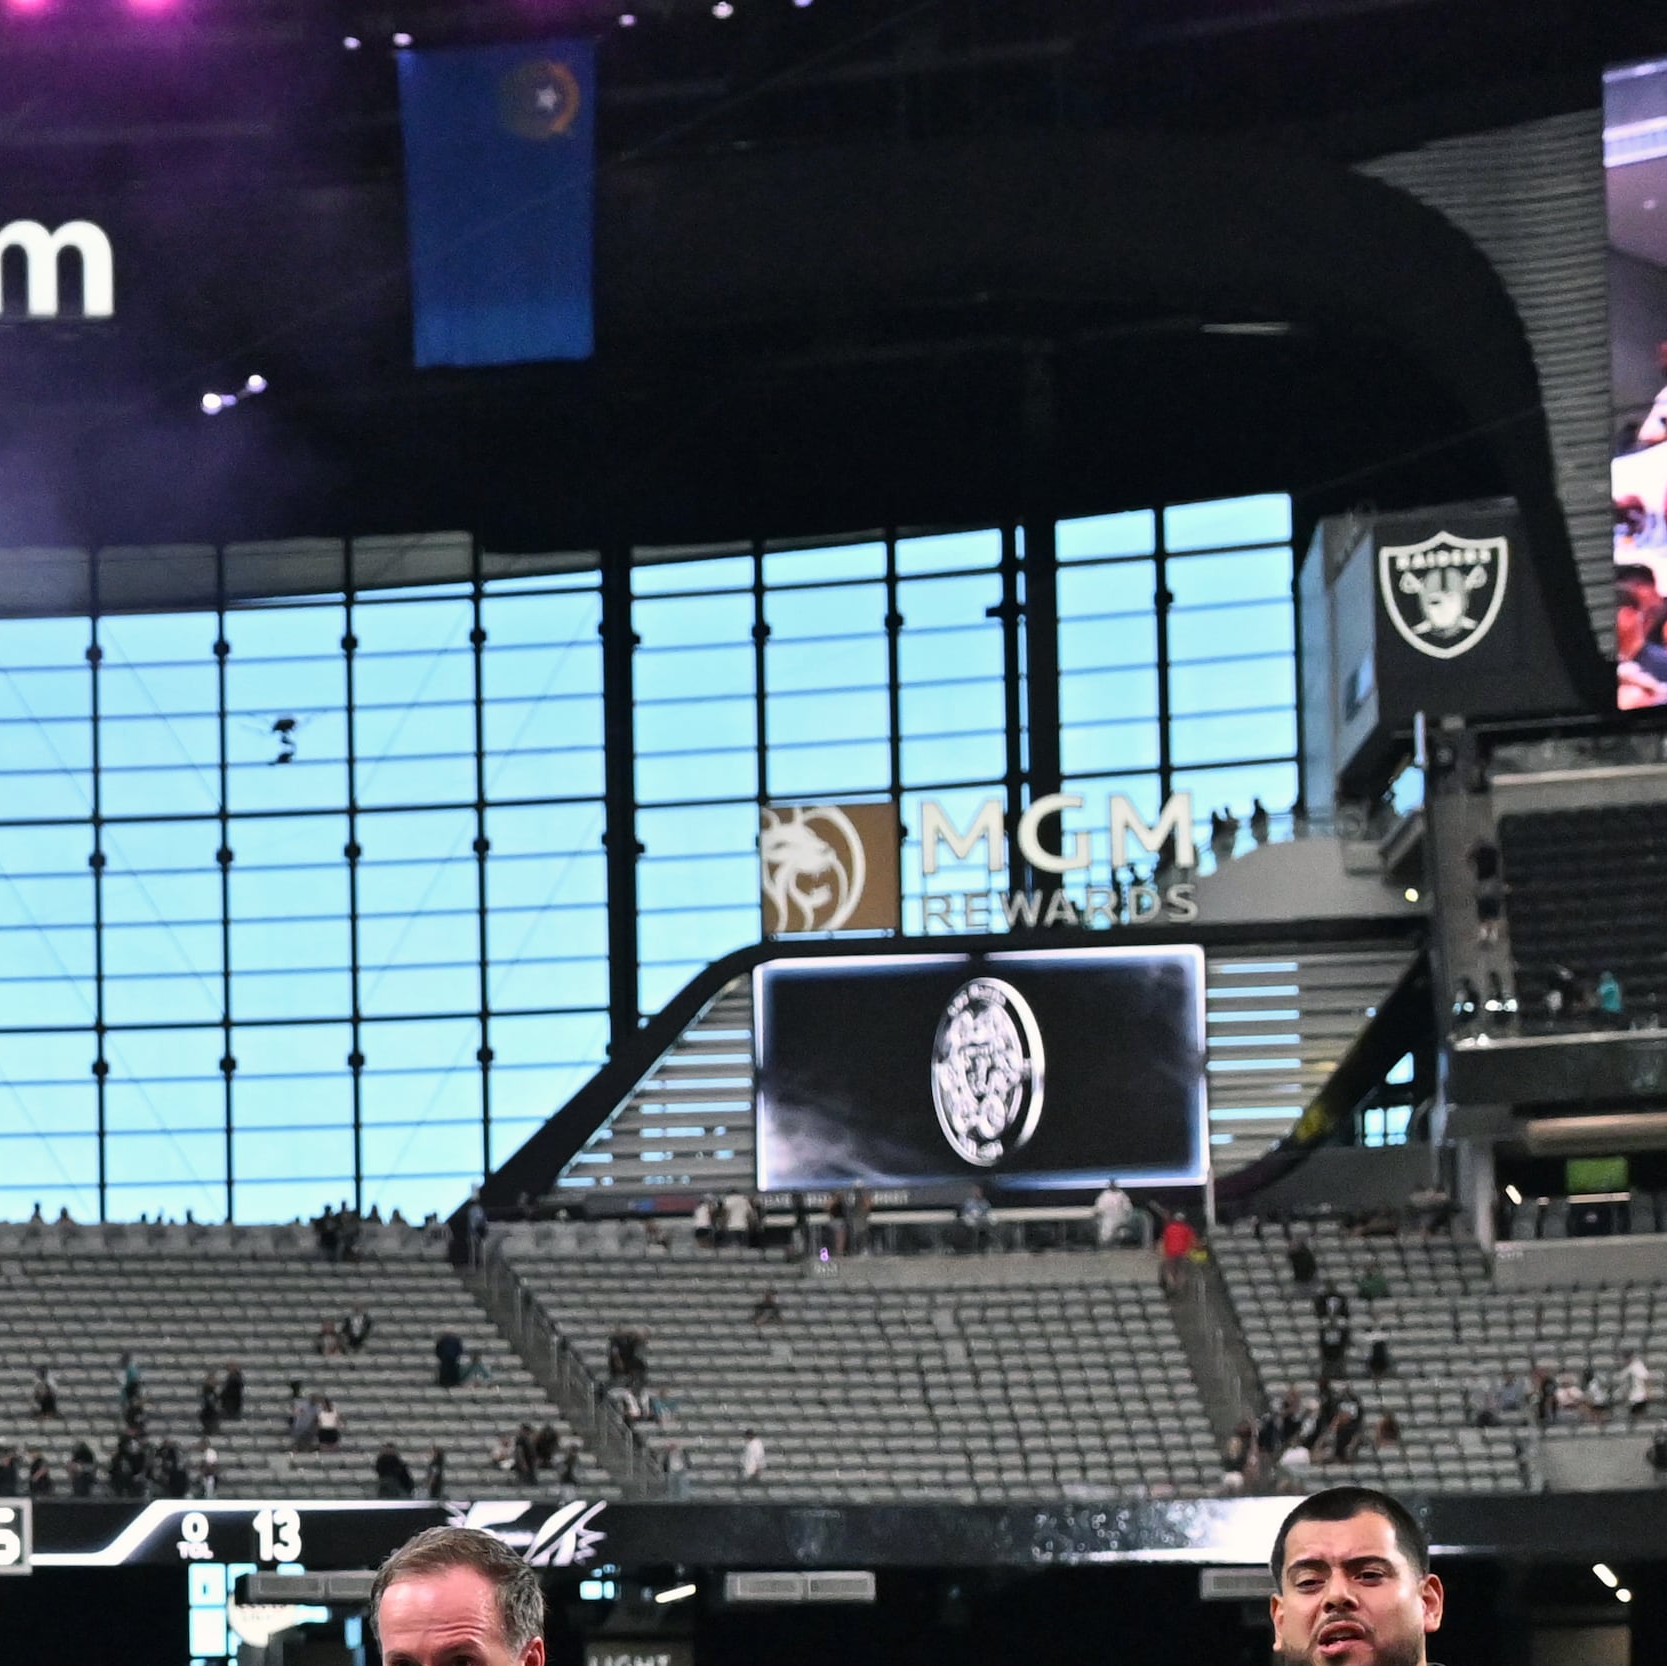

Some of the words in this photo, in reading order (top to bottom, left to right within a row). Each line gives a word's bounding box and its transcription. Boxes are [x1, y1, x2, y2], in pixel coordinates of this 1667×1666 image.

[1395, 548, 1491, 571] RAIDERS
[921, 790, 1199, 874] MGM
[923, 883, 1200, 934] REWARDS
[181, 1512, 210, 1542] 0
[253, 1509, 303, 1562] 13
